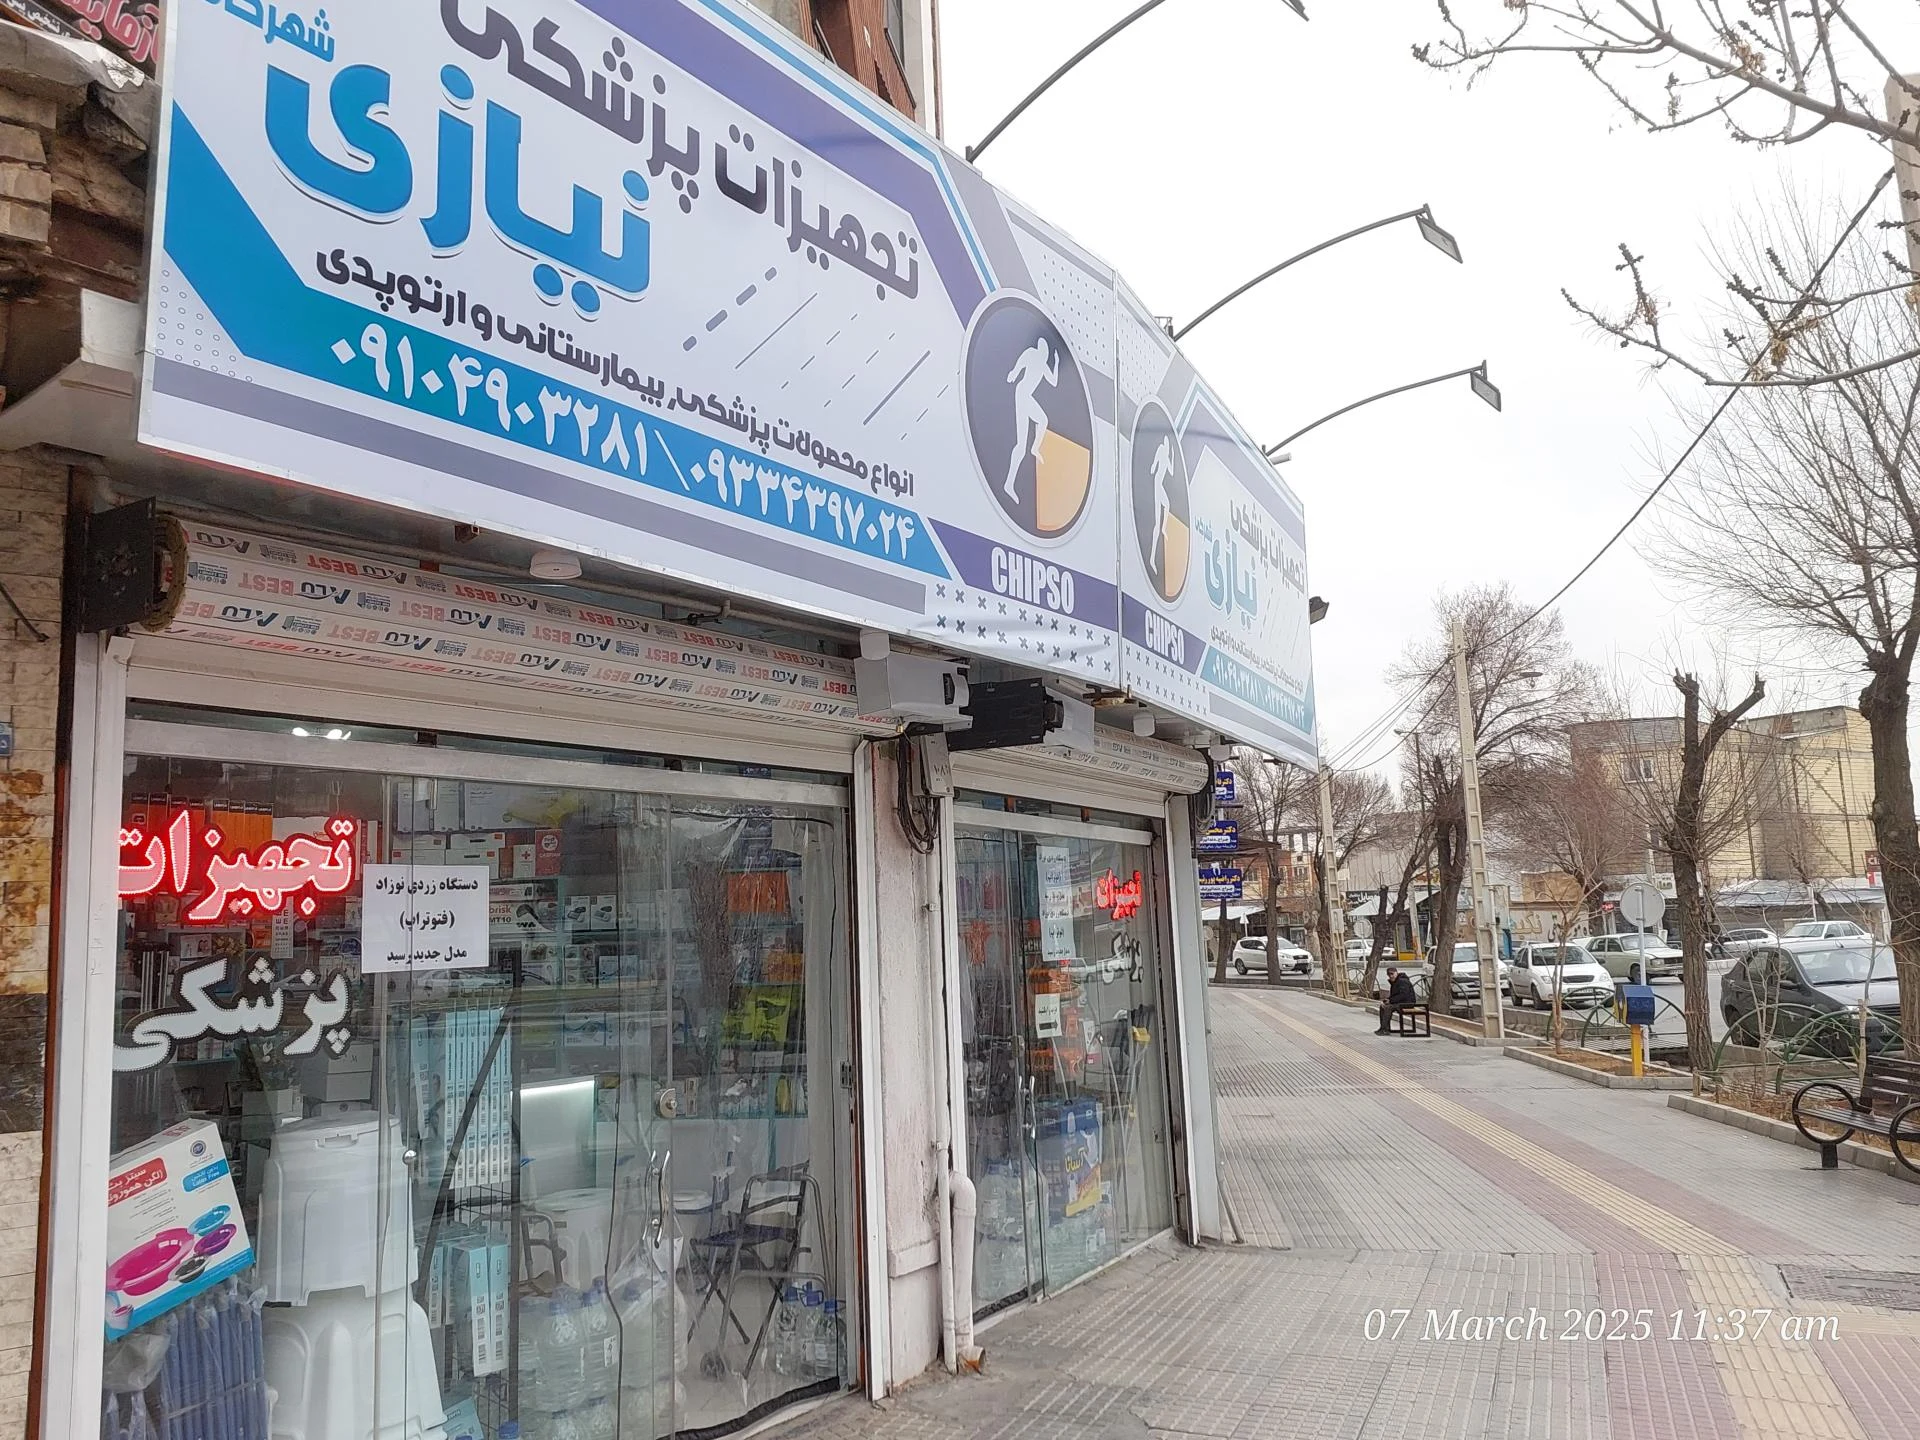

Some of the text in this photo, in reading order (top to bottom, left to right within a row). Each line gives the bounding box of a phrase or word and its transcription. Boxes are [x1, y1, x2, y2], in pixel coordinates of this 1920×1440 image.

[440, 0, 919, 301] تجهیزات پزشکی
[264, 63, 651, 316] نیازی
[316, 248, 467, 326] ارتوپدی
[471, 304, 492, 341] و
[497, 314, 665, 408] بیمارستانی
[773, 418, 867, 479] محصولات
[870, 463, 914, 497] انواع
[991, 546, 1075, 615] CHIPSO
[1204, 528, 1258, 631] نیازی
[1144, 609, 1185, 665] CHIPSO
[118, 810, 352, 920] تجهیزات
[376, 876, 479, 895] دستگاه زردی نوزاد
[413, 949, 441, 963] جدید
[444, 946, 468, 961] مدل
[113, 956, 351, 1072] پزشکی
